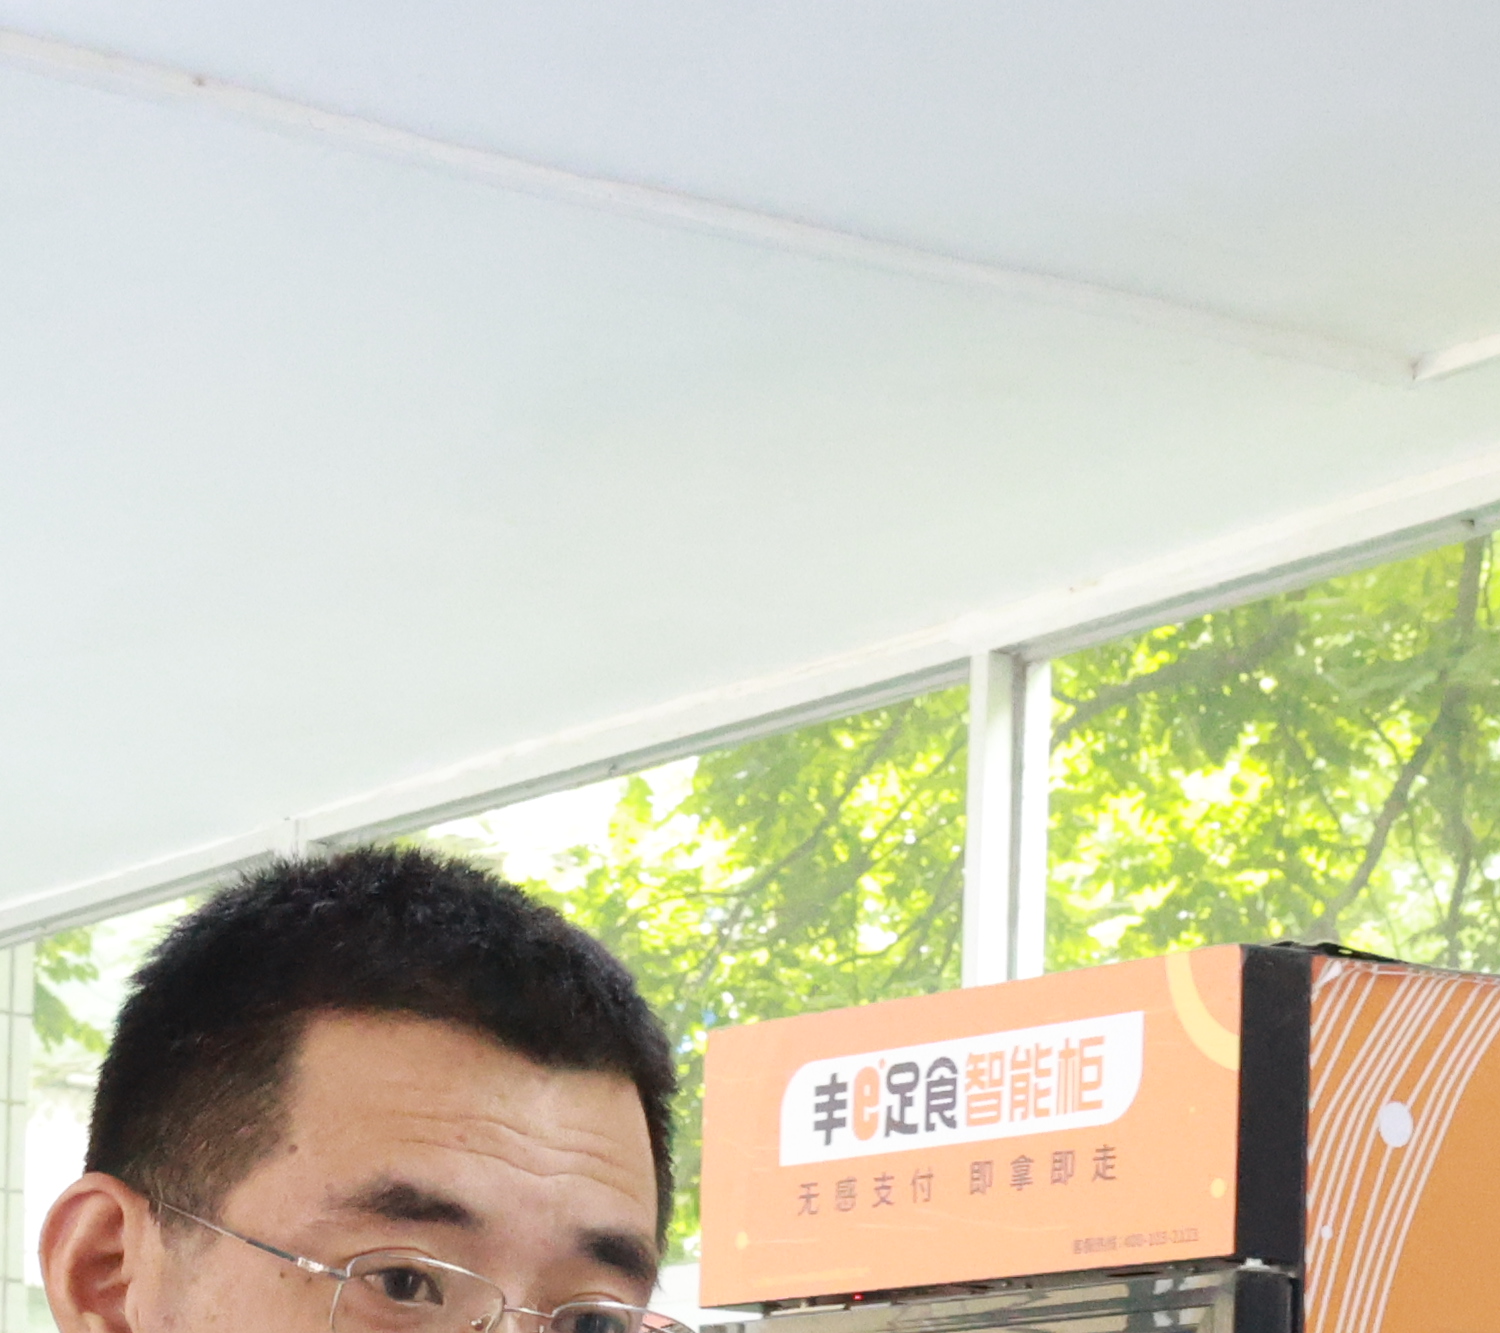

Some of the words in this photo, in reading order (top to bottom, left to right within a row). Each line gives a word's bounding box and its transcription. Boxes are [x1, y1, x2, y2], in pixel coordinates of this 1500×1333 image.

[813, 1036, 1106, 1146] 丰e足食智能柜
[797, 1168, 935, 1217] 无感支付
[969, 1144, 1118, 1196] 即拿即走
